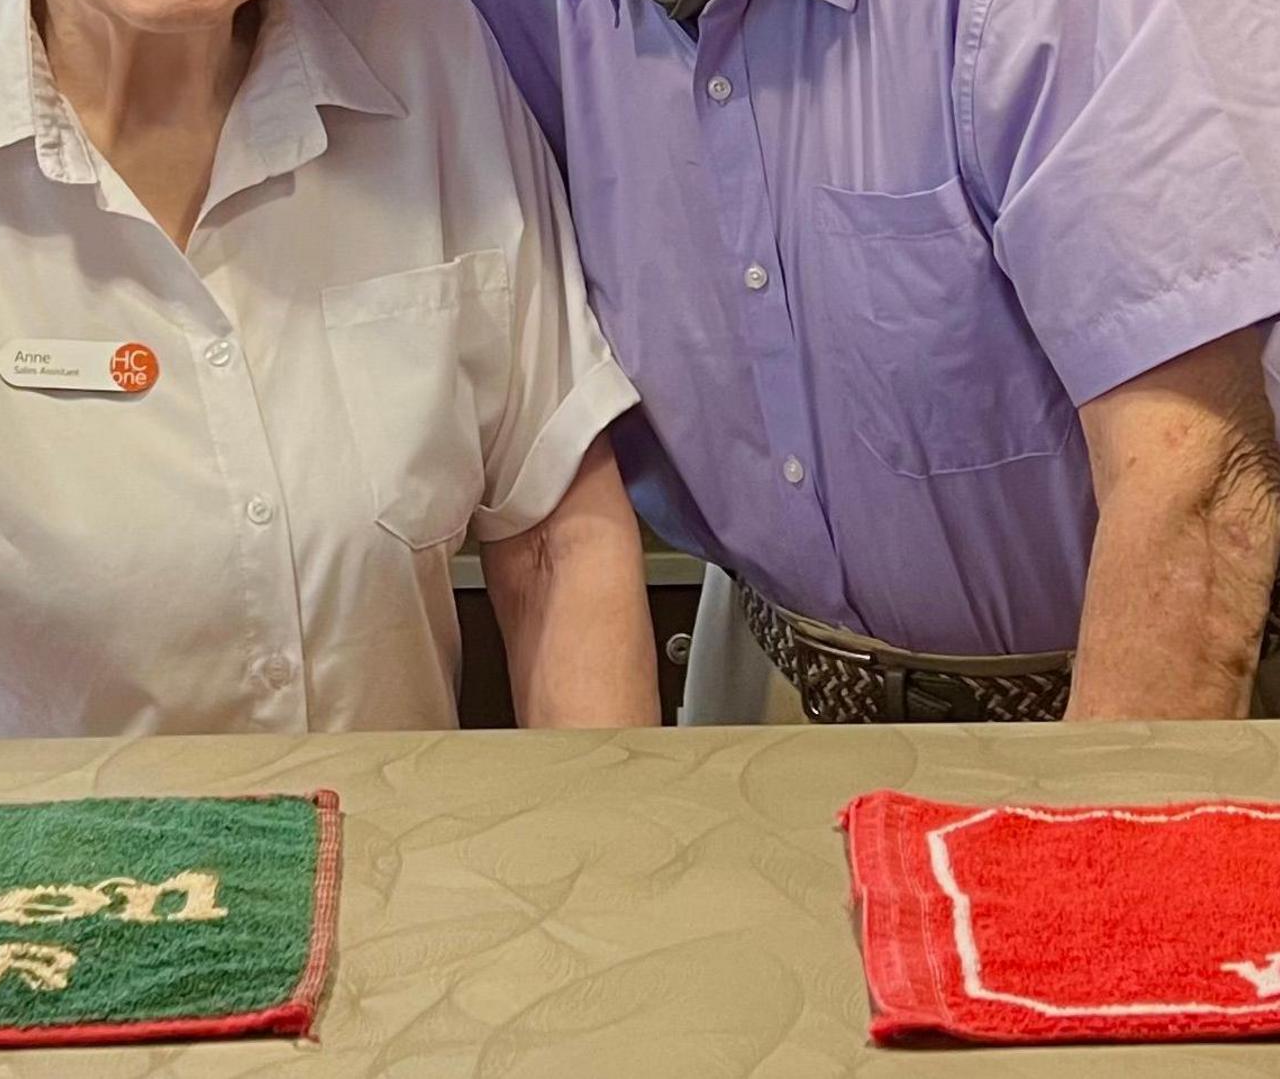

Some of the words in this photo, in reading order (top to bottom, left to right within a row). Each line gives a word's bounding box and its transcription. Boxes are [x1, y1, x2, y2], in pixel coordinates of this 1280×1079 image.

[14, 350, 51, 364] Anne
[112, 349, 148, 371] HC
[110, 371, 148, 386] one
